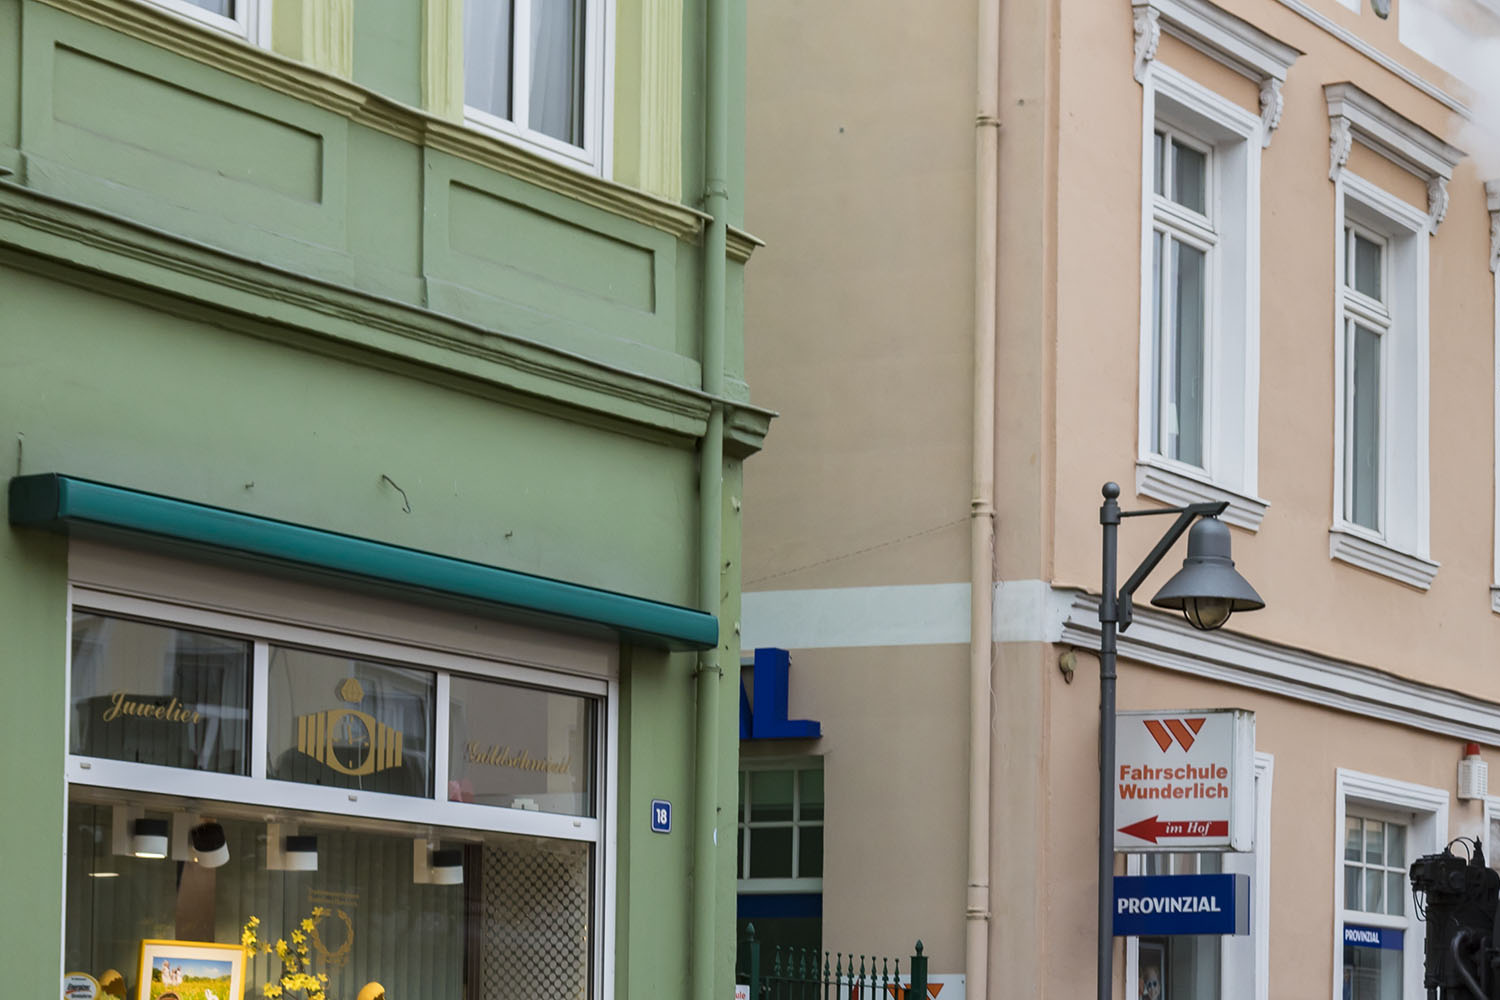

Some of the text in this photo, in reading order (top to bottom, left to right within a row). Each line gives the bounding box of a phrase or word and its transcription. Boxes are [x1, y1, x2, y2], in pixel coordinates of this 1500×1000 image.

[103, 689, 200, 724] Juwelier
[1119, 764, 1228, 780] Fahrschule
[1119, 783, 1229, 800] Wunderlich
[656, 808, 668, 824] 18
[1165, 821, 1212, 836] im Hof
[1117, 896, 1221, 914] PROVINZIAL
[1344, 928, 1380, 944] PROVINZIAL
